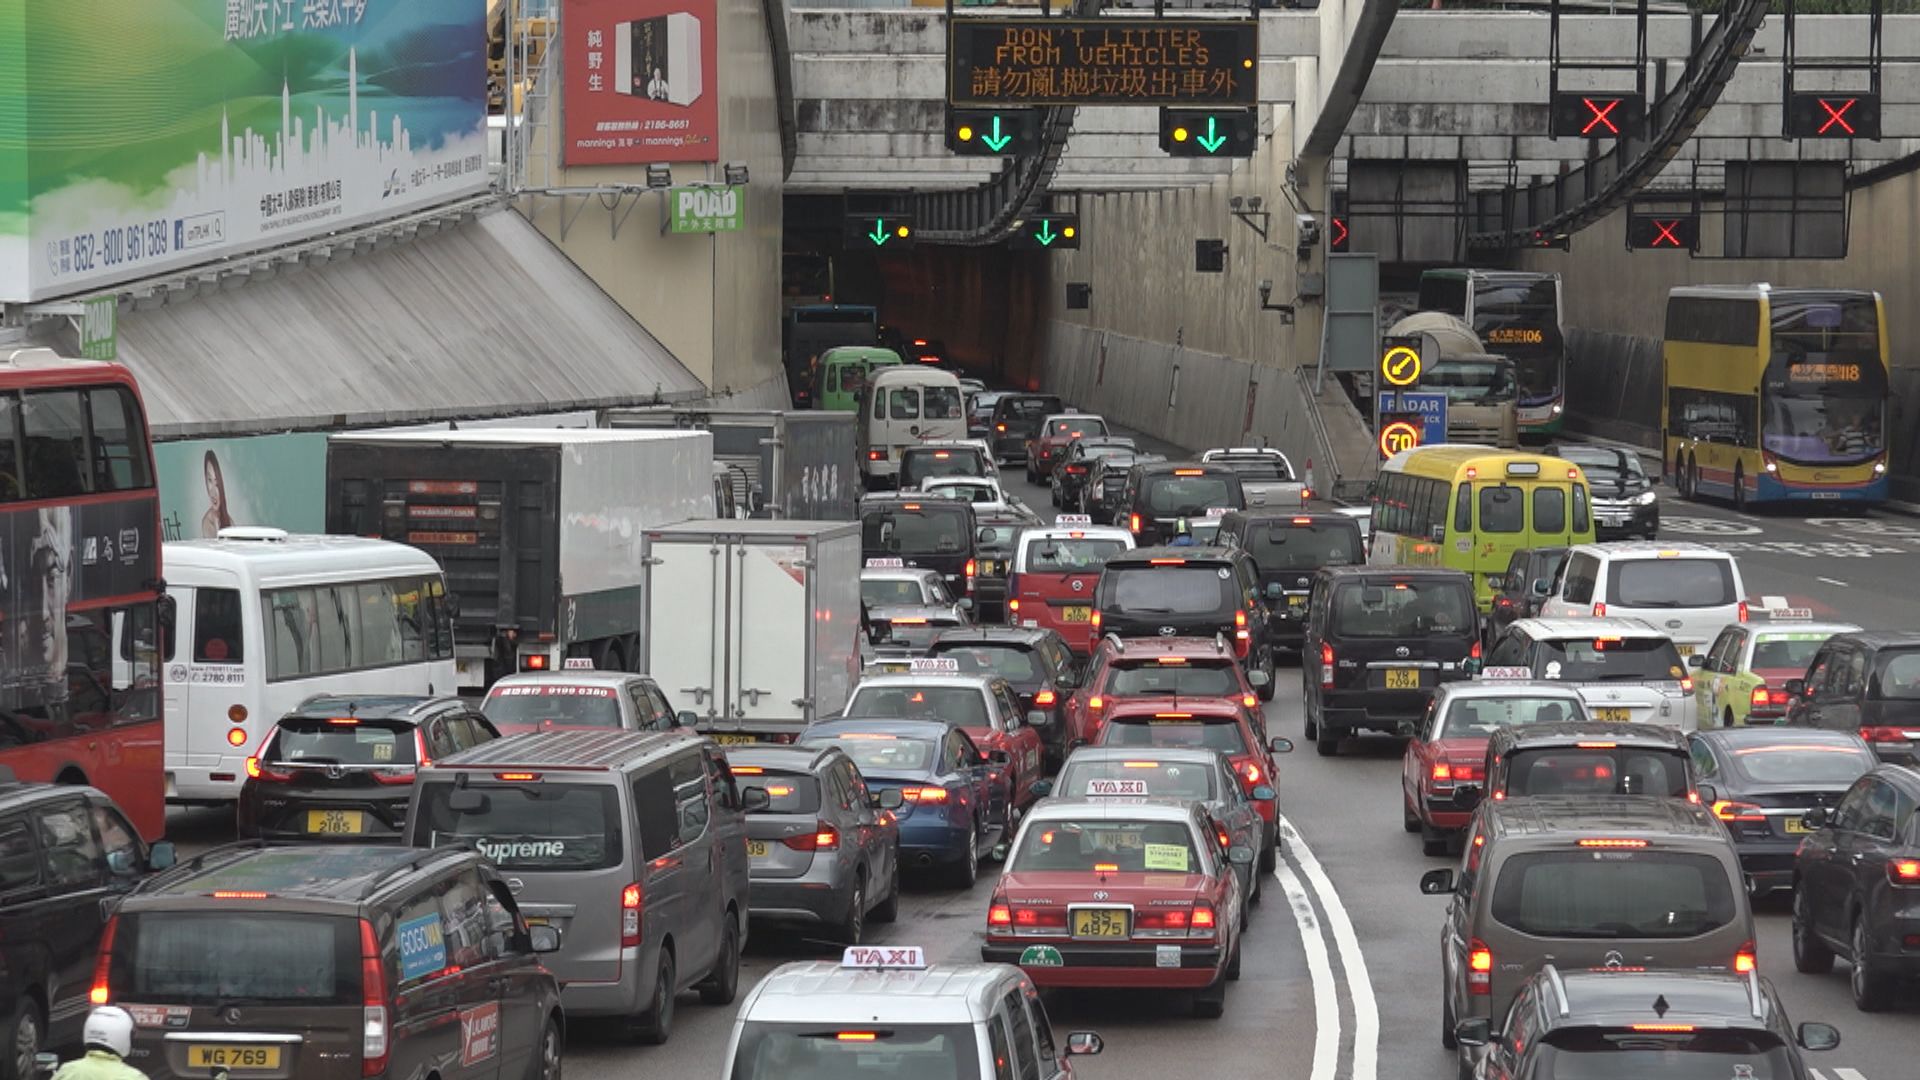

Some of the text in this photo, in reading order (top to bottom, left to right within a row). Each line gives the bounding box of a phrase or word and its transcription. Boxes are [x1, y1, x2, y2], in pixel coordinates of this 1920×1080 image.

[1006, 28, 1200, 46] DON'T LITTER
[587, 30, 603, 92] 純野生
[996, 46, 1209, 64] FROM VEHICLES
[971, 67, 1238, 97] 請勿亂拋垃圾出車外
[576, 139, 616, 149] mannings
[645, 137, 684, 146] mannings
[679, 190, 737, 217] POAD
[74, 228, 123, 272] 852-800
[127, 223, 145, 262] 961
[148, 219, 168, 257] 589
[1522, 329, 1542, 343] 106
[1839, 363, 1860, 381] 118
[1389, 433, 1412, 453] 70
[1773, 608, 1809, 618] TAXI
[567, 660, 591, 668] TAXI
[915, 660, 954, 669] TAXI
[202, 673, 245, 683] 2780 8111
[1487, 669, 1527, 678] TAXI
[1091, 781, 1143, 793] TAXI
[326, 810, 344, 821] SG
[319, 821, 350, 833] 2185
[475, 838, 565, 865] Supreme
[1090, 911, 1111, 924] SS
[1080, 923, 1121, 935] 4875
[851, 950, 917, 964] TAXI
[1037, 950, 1045, 959] 4
[201, 1049, 267, 1065] WG 769
